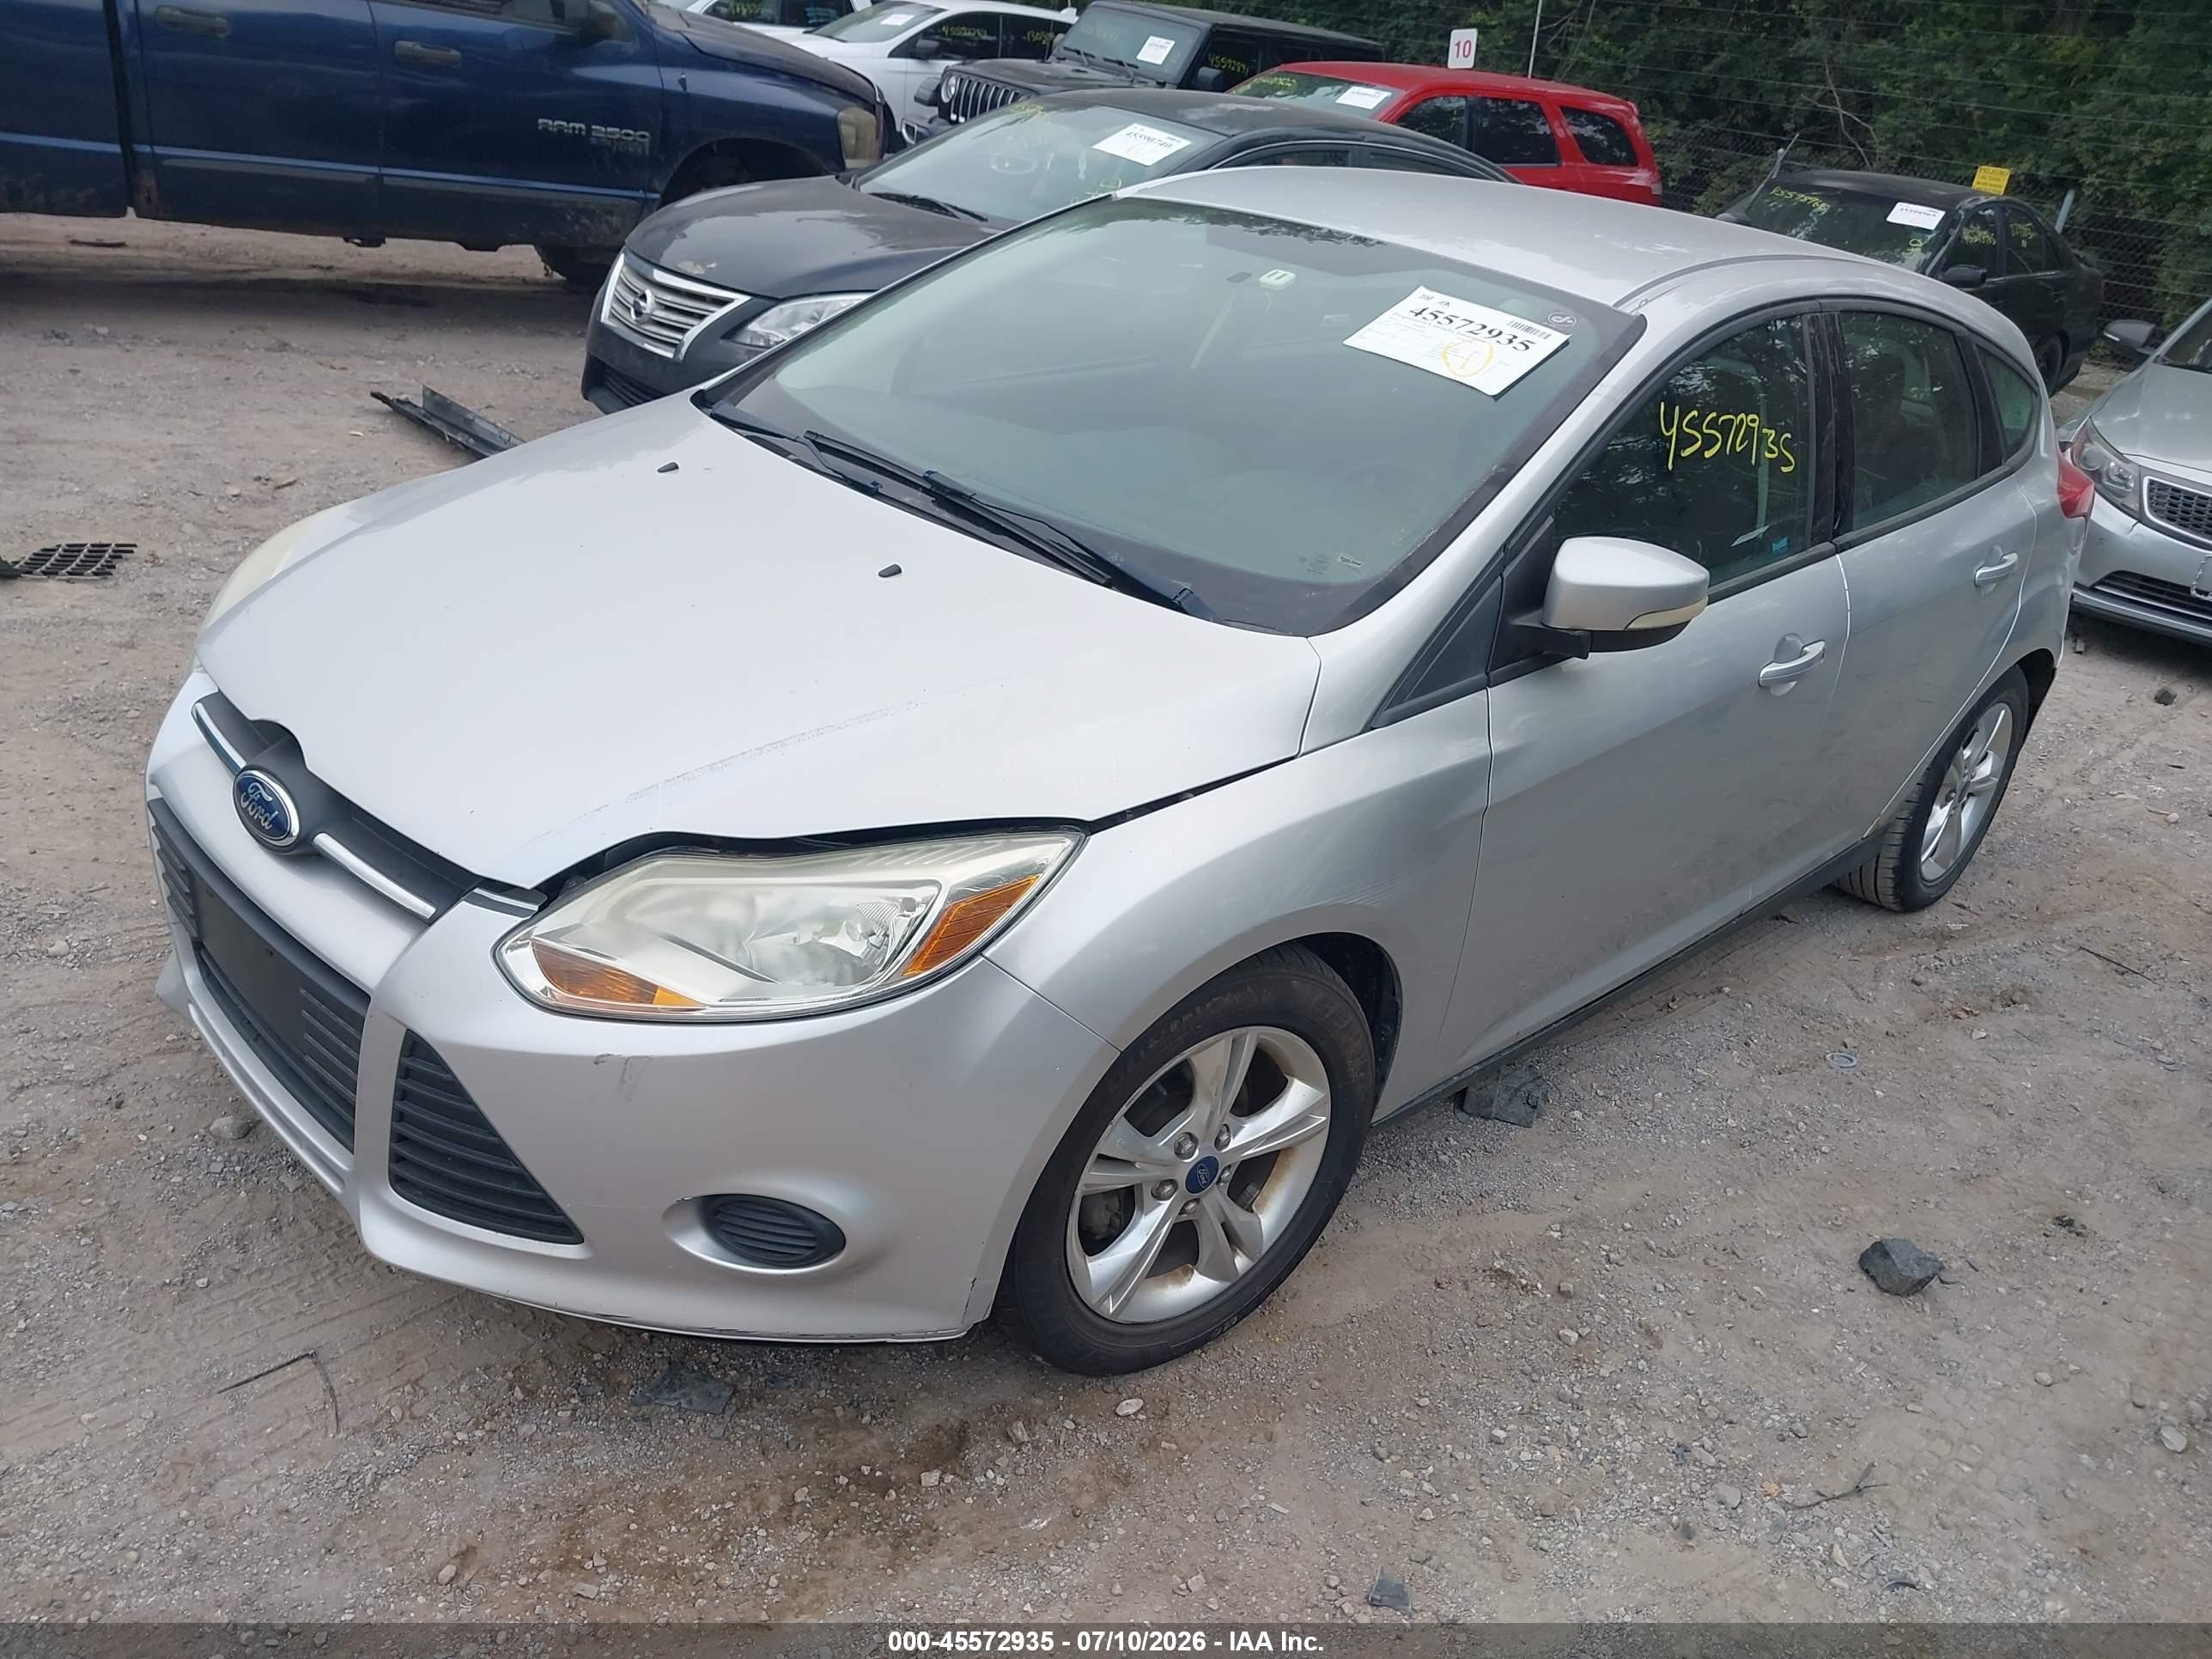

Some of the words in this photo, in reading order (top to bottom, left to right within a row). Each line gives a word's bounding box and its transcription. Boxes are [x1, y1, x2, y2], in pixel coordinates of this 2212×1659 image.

[1454, 40, 1472, 58] 10
[538, 118, 586, 136] RAM
[591, 125, 650, 142] 2500
[1409, 307, 1537, 352] 45572935
[1660, 401, 1796, 473] 45572935
[240, 781, 279, 830] Ford
